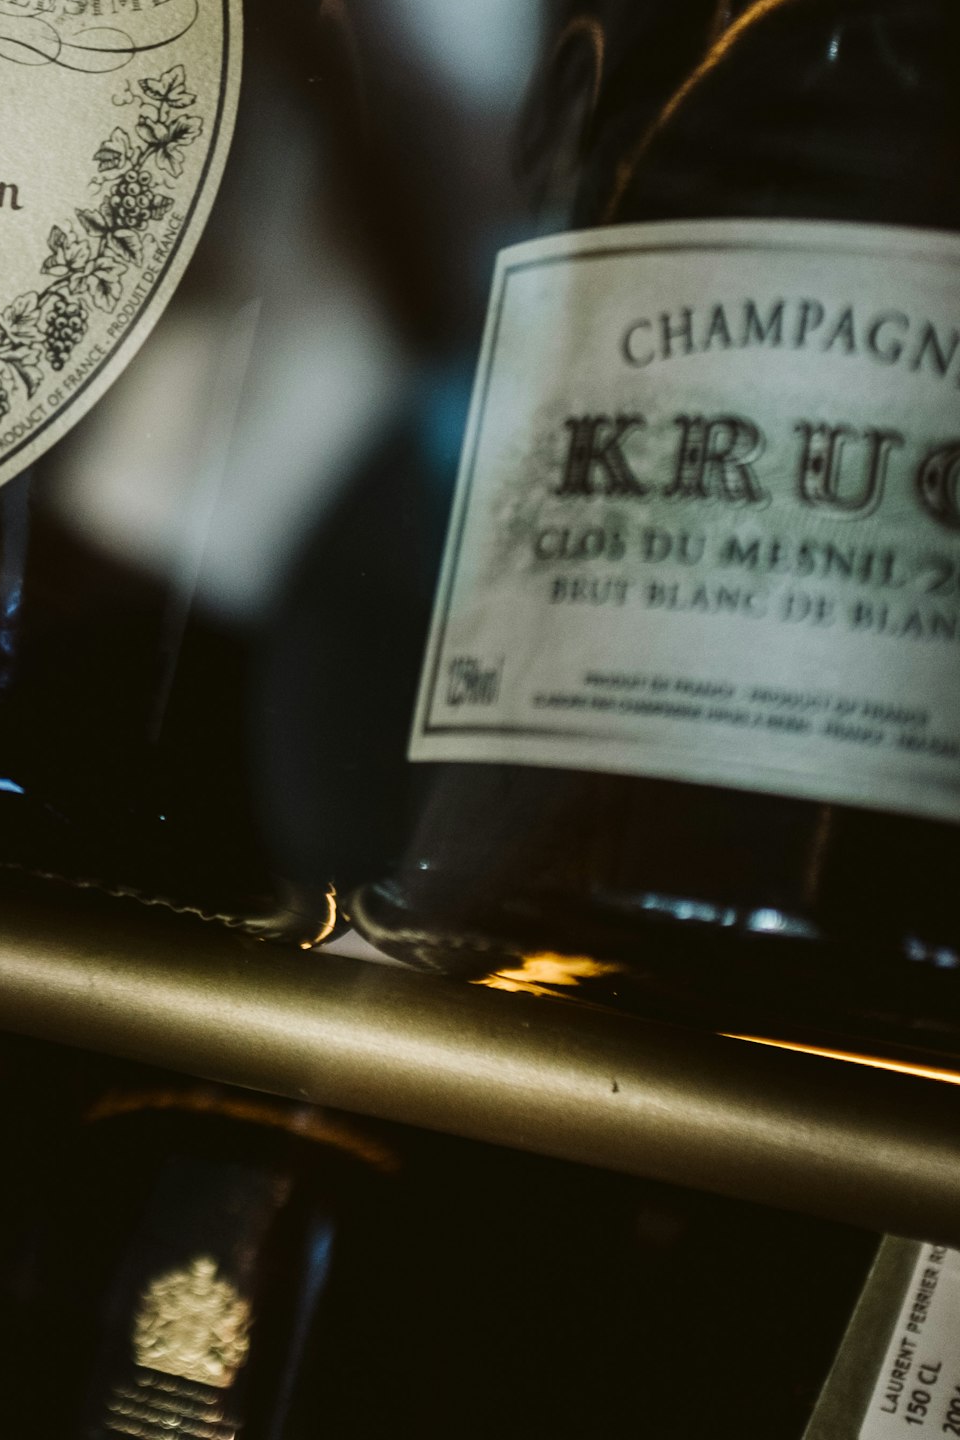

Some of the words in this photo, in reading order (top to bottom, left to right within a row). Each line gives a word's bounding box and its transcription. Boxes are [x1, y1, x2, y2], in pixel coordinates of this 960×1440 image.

[47, 388, 65, 407] OF
[63, 344, 106, 390] FRANCE
[107, 286, 147, 338] PRODUIT
[143, 264, 160, 284] DE
[153, 213, 185, 264] FRANCE
[620, 295, 960, 390] CHAMPAGN
[642, 527, 707, 565] DU
[549, 574, 631, 606] BRUT
[646, 578, 767, 619] BLANC
[880, 1337, 917, 1414] LAURENT
[906, 1268, 939, 1334] PERRIER
[904, 1390, 931, 1426] 150
[918, 1361, 942, 1386] CL
[942, 1385, 960, 1437] 200
